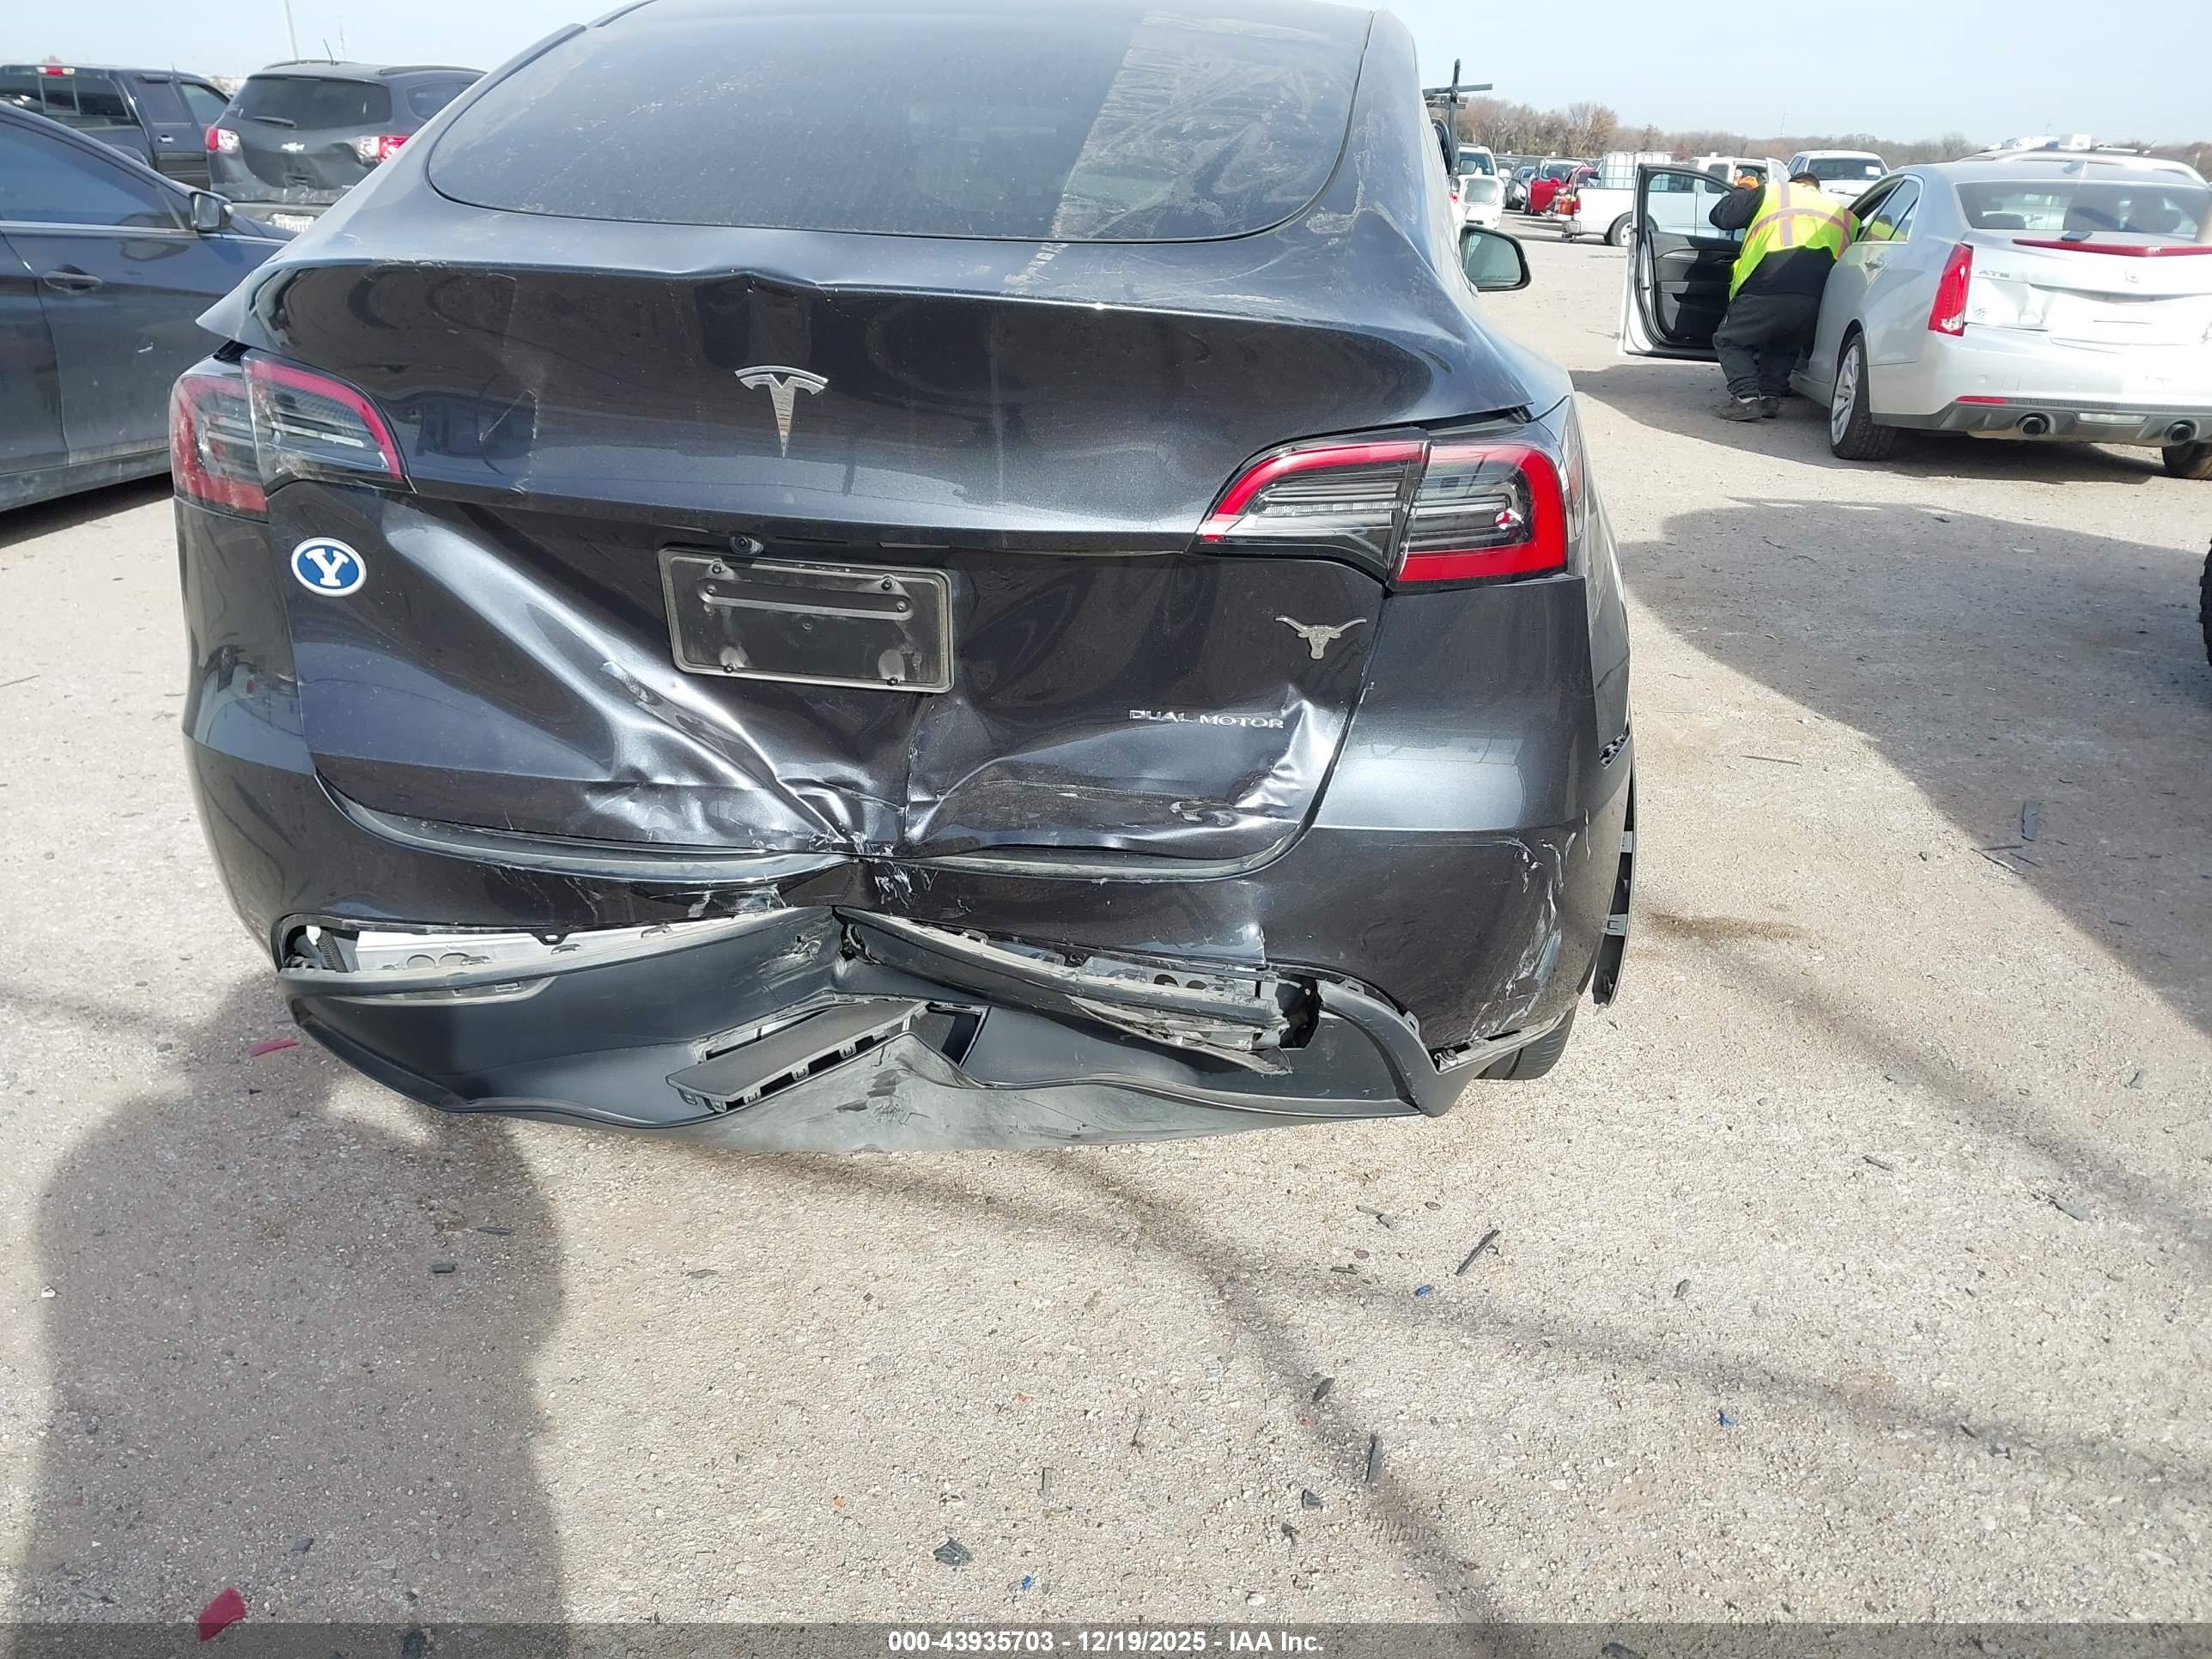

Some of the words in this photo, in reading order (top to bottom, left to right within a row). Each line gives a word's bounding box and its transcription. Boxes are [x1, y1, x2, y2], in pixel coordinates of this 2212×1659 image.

[305, 548, 349, 586] Y
[1129, 709, 1194, 723] DUAL
[1199, 714, 1285, 729] MOTOR
